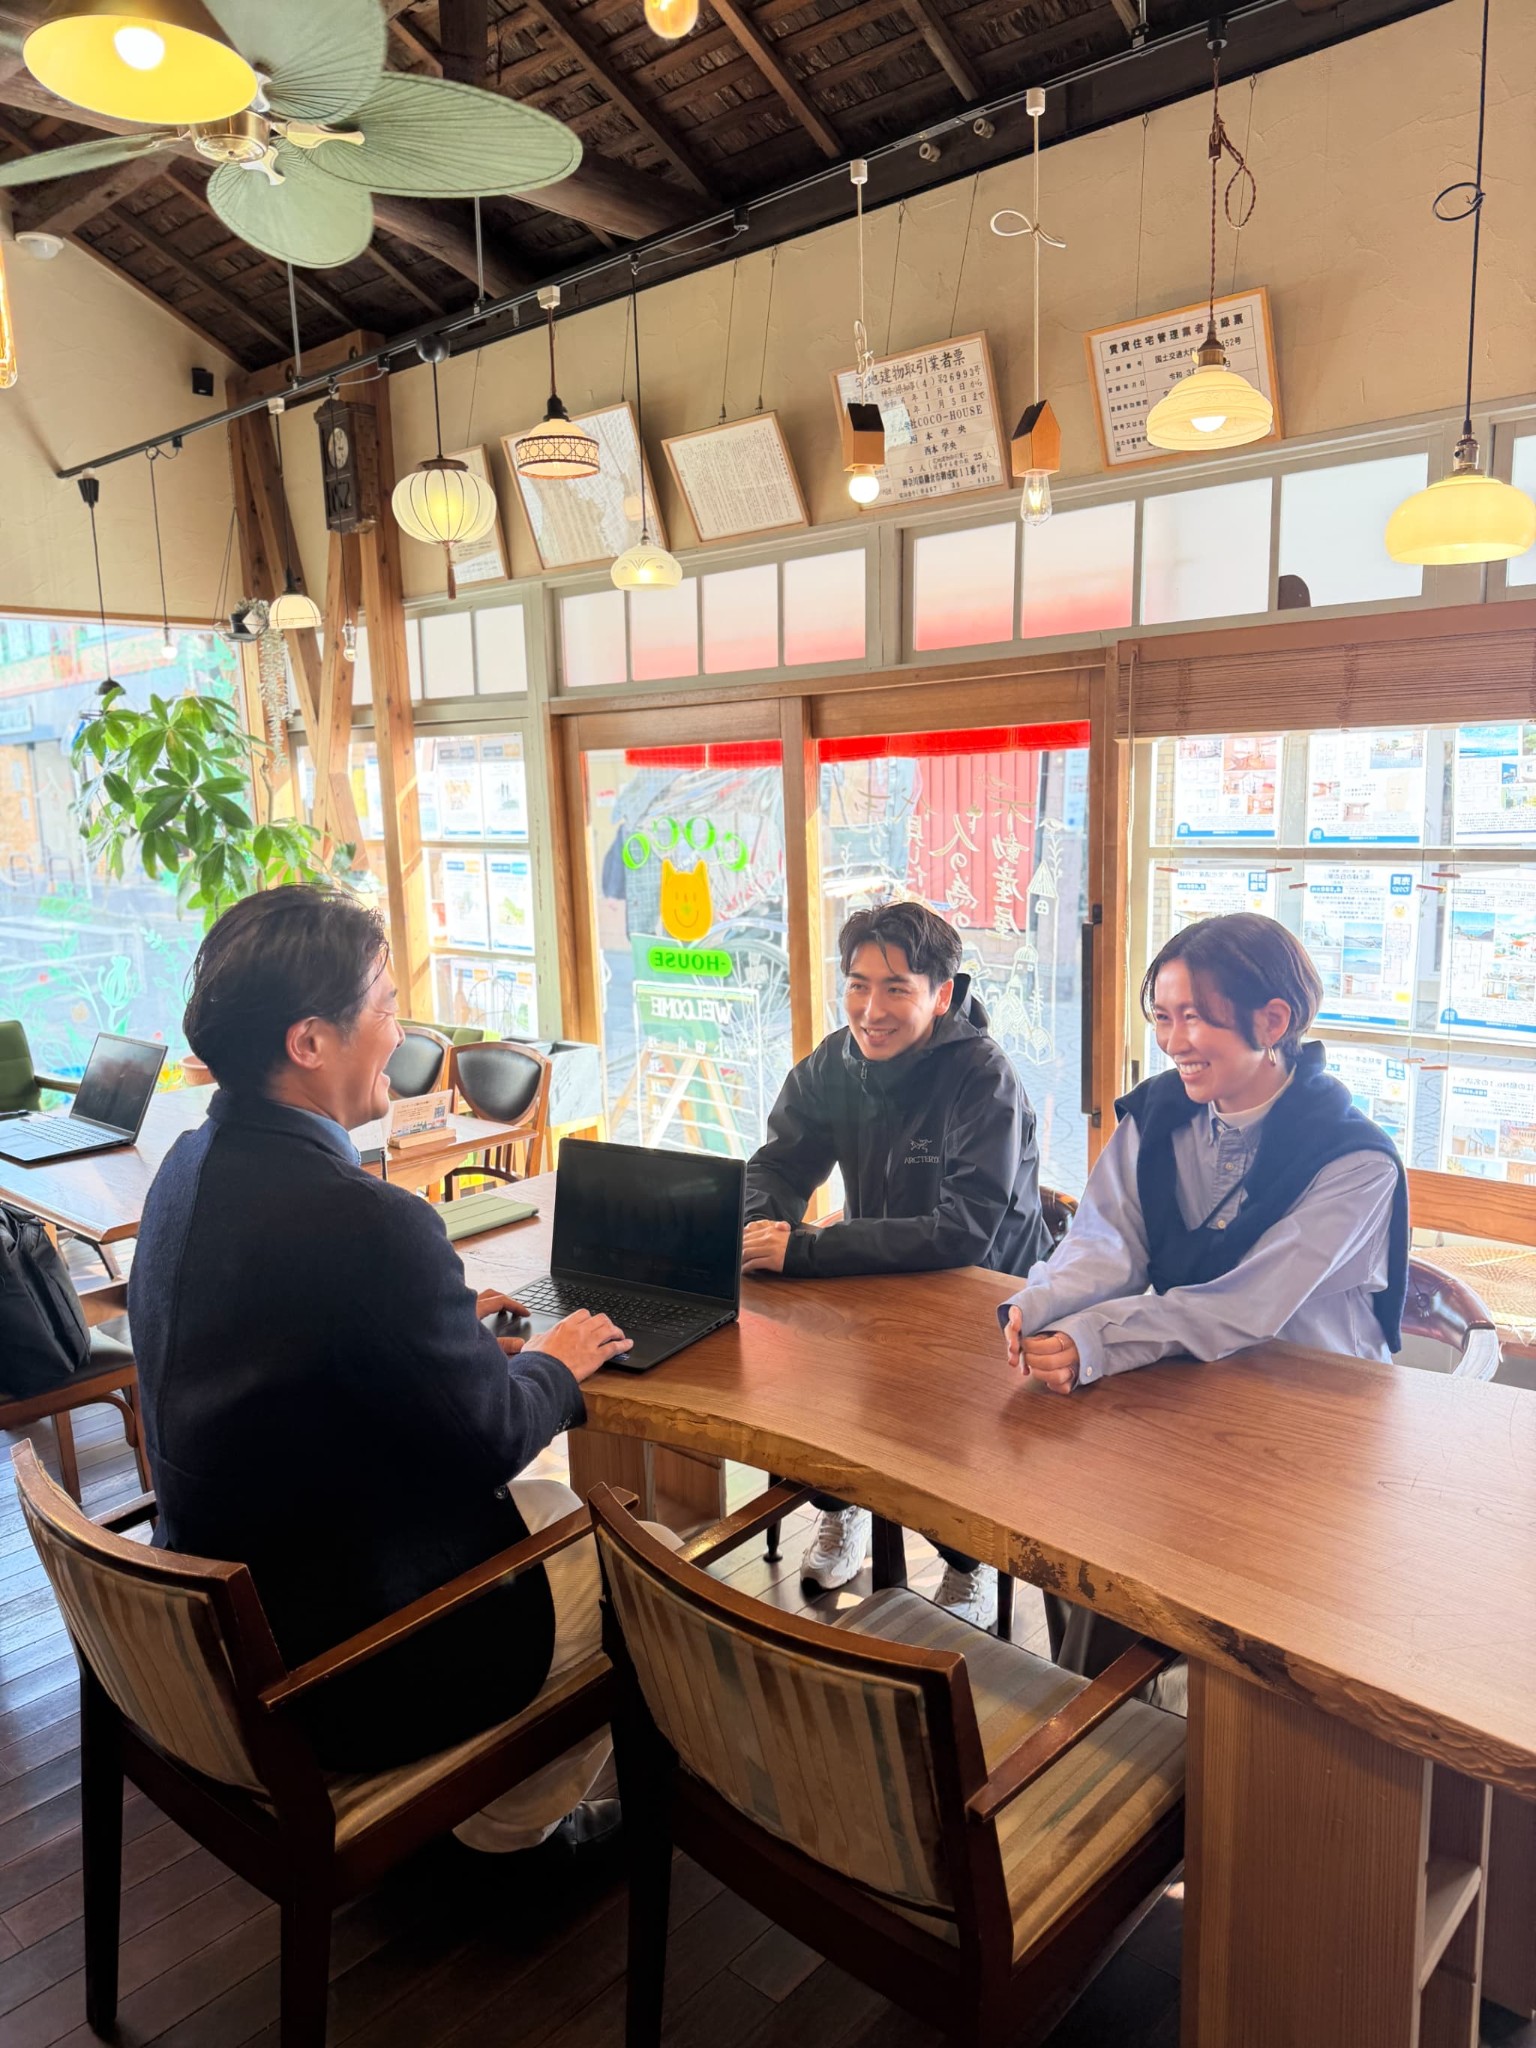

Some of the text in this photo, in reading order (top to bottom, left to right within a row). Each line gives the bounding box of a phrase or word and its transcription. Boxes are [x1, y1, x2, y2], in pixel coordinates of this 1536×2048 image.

[1108, 313, 1244, 355] 賃貸住宅管理業者録票
